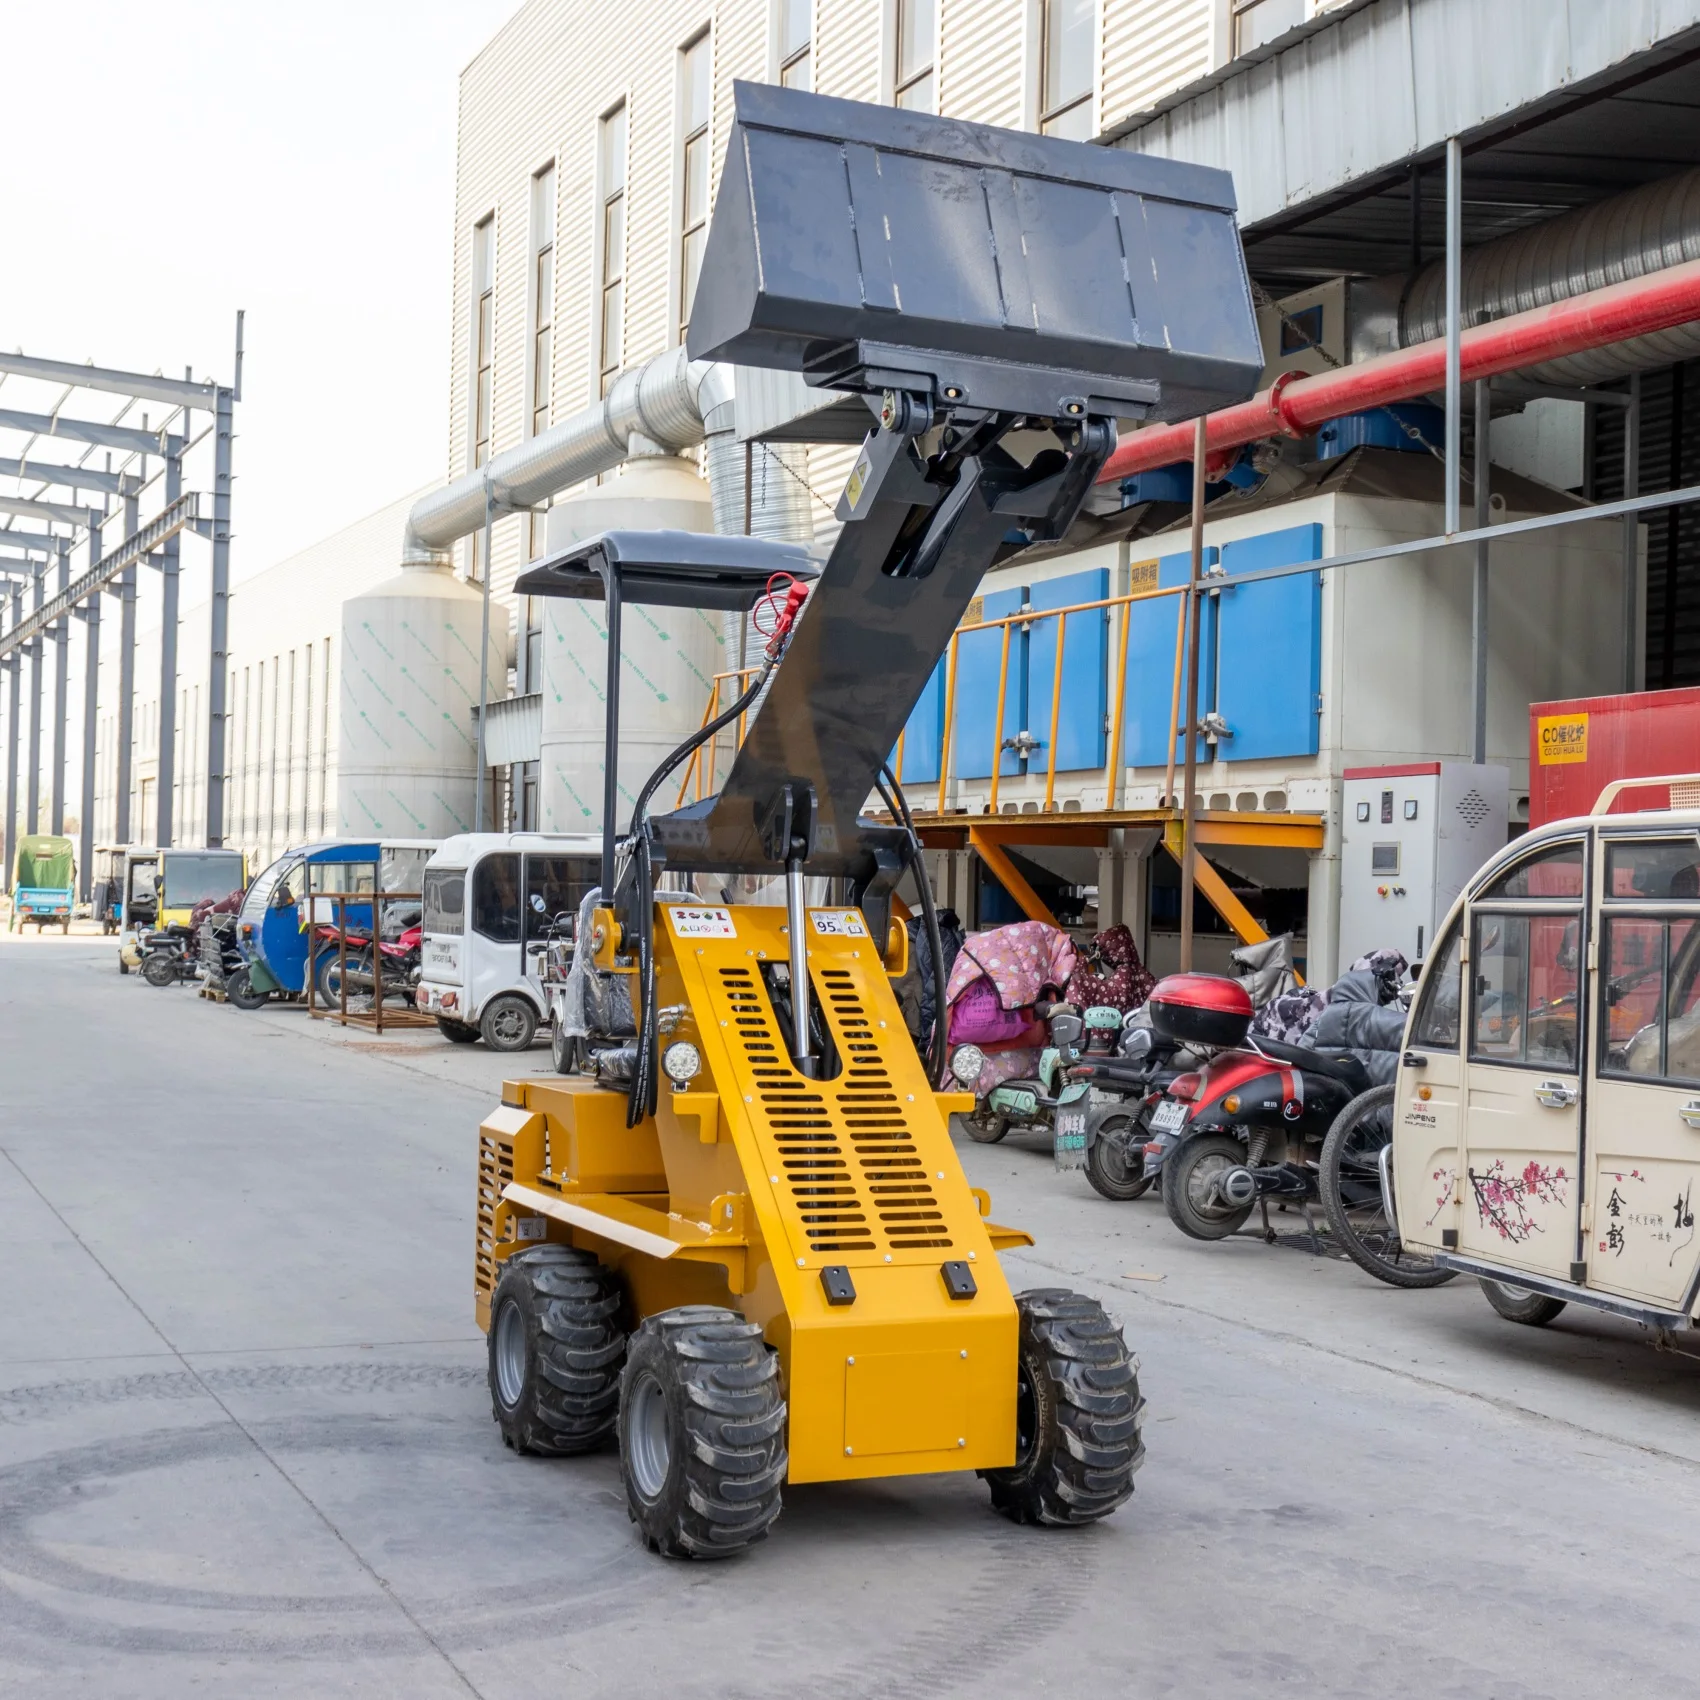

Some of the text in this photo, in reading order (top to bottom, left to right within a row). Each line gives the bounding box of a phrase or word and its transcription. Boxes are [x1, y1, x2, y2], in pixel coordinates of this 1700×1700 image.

[817, 921, 836, 932] 95
[1405, 1113, 1436, 1123] JINPENG
[1606, 1187, 1627, 1257] 金彭
